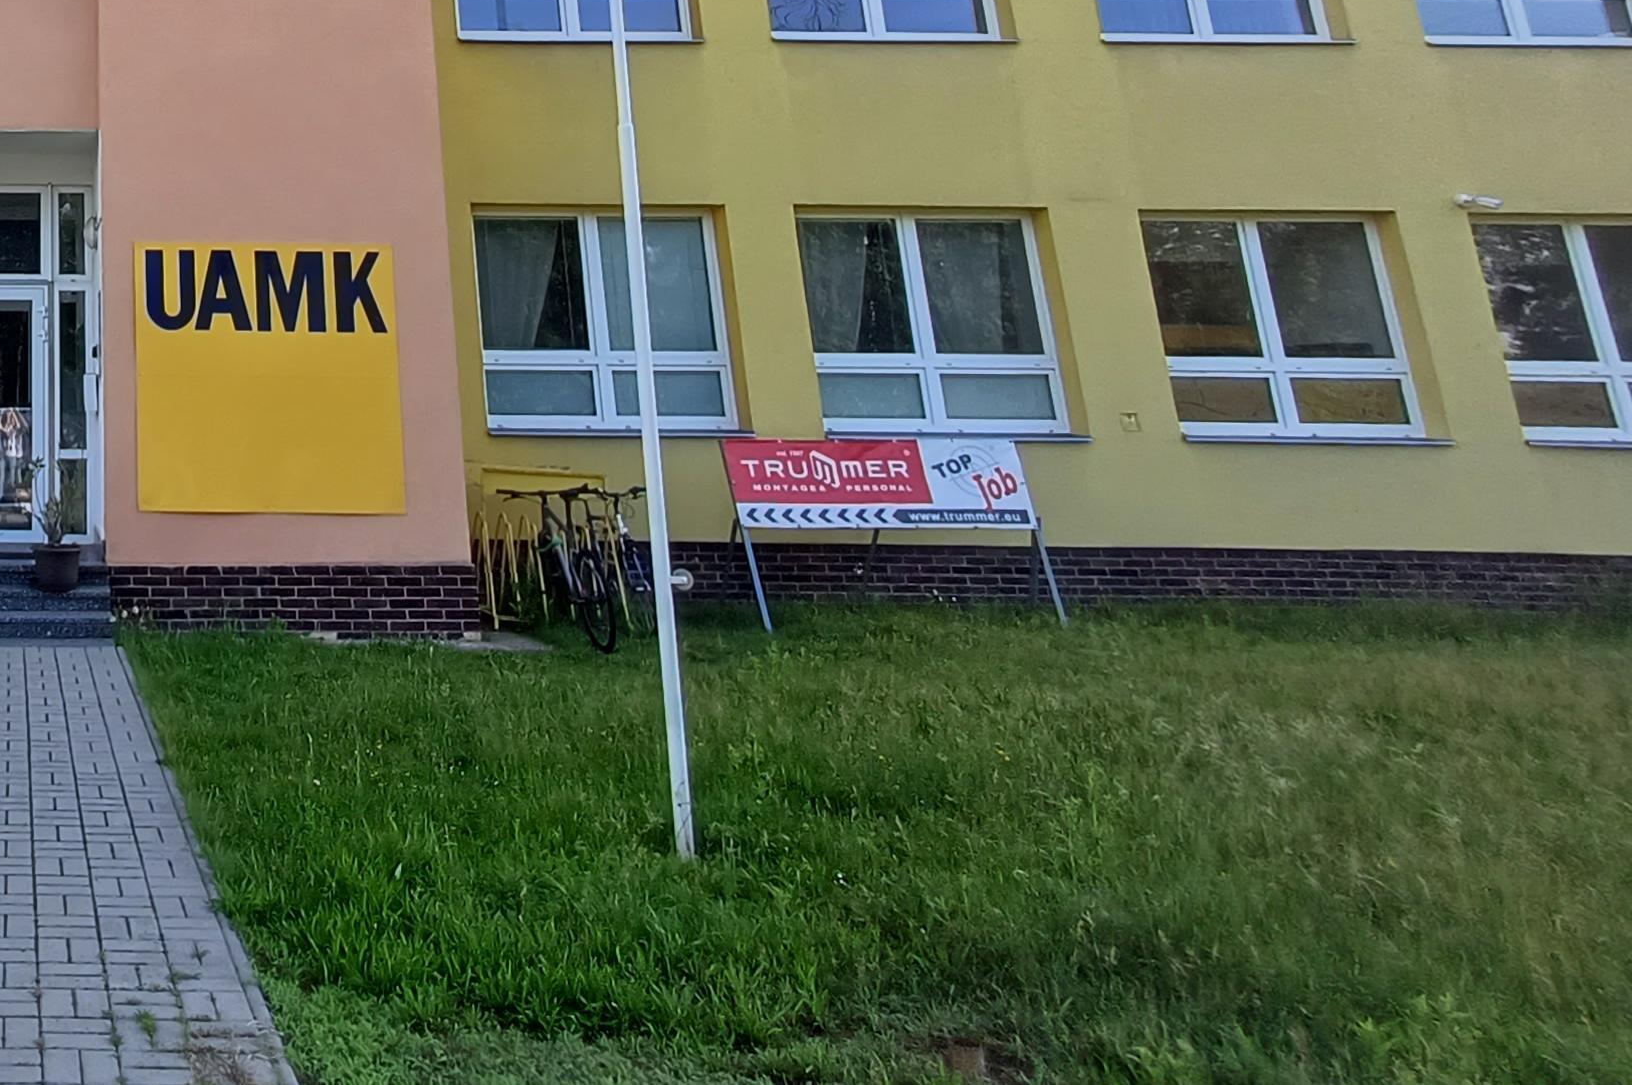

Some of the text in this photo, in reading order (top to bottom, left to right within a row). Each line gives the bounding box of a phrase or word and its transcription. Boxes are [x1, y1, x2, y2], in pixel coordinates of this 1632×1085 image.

[145, 249, 388, 333] UAMK
[931, 454, 972, 478] TOP
[846, 484, 912, 492] PERSONAL
[908, 512, 1021, 522] www.trummer.eu
